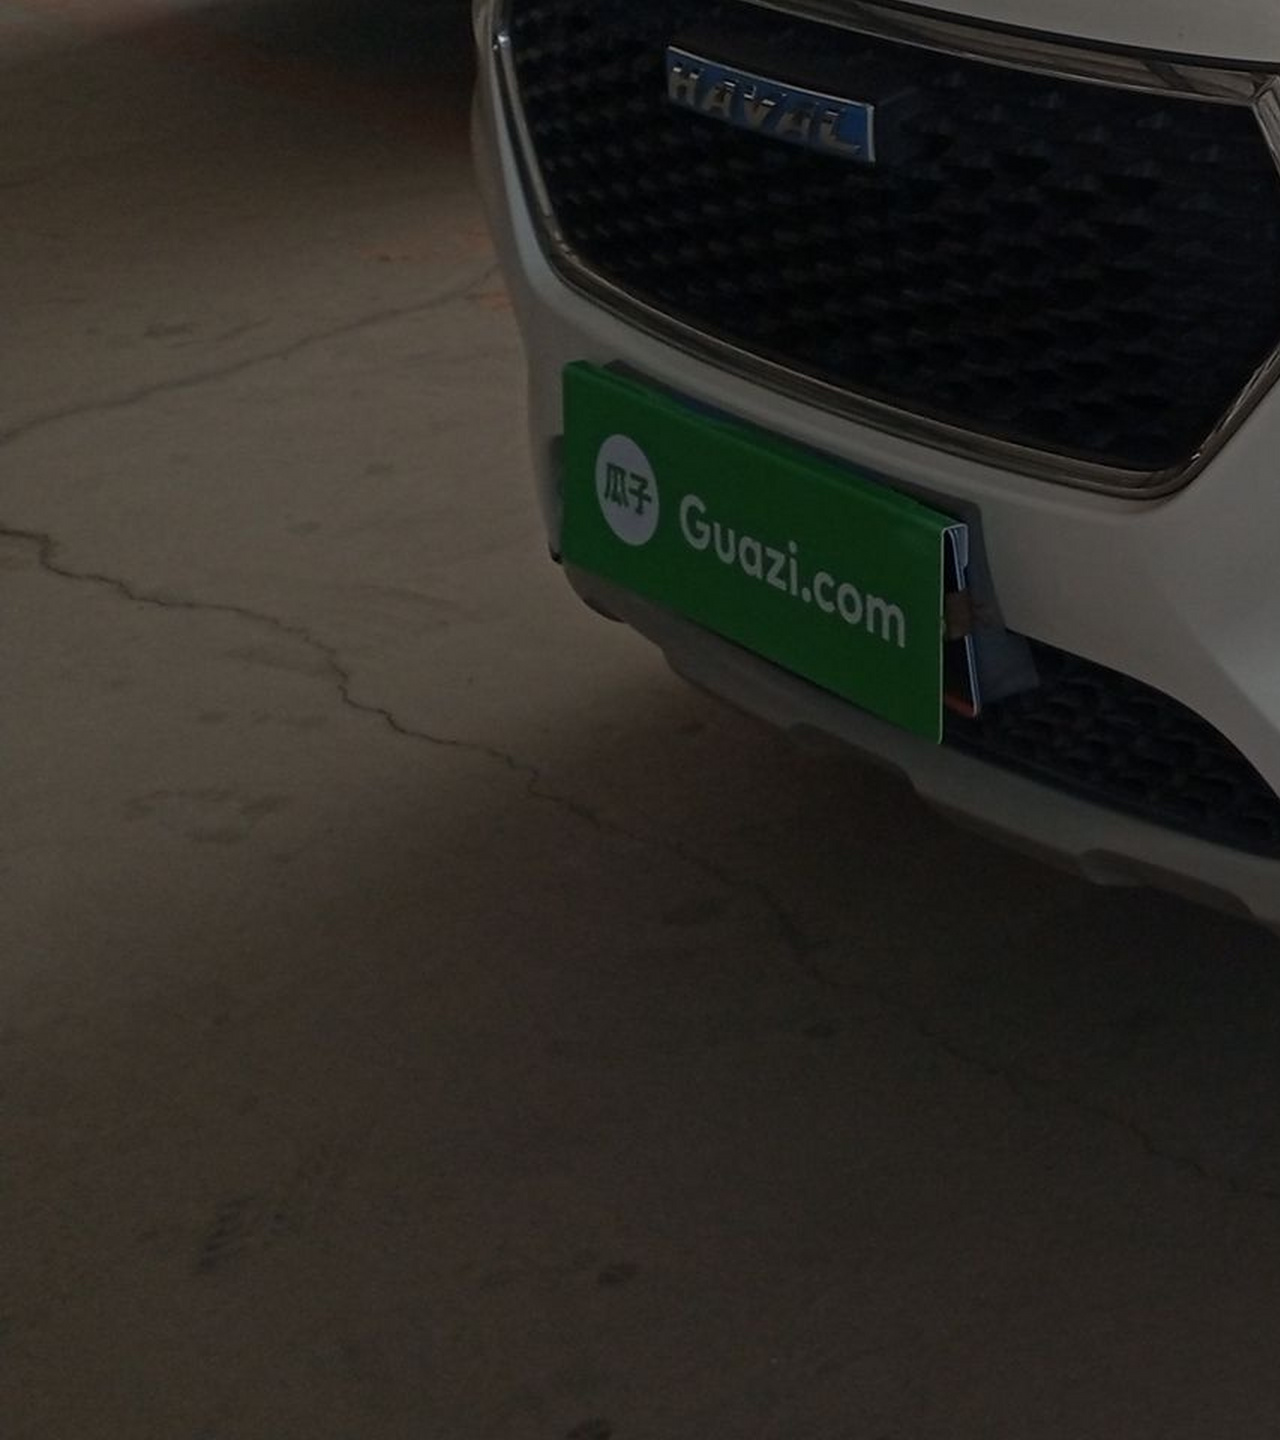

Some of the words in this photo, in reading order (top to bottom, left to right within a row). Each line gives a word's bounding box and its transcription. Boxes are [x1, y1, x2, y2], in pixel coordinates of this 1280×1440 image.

[669, 60, 862, 158] HAVAL
[602, 462, 653, 516] 瓜子
[678, 493, 906, 648] Guazi.com
